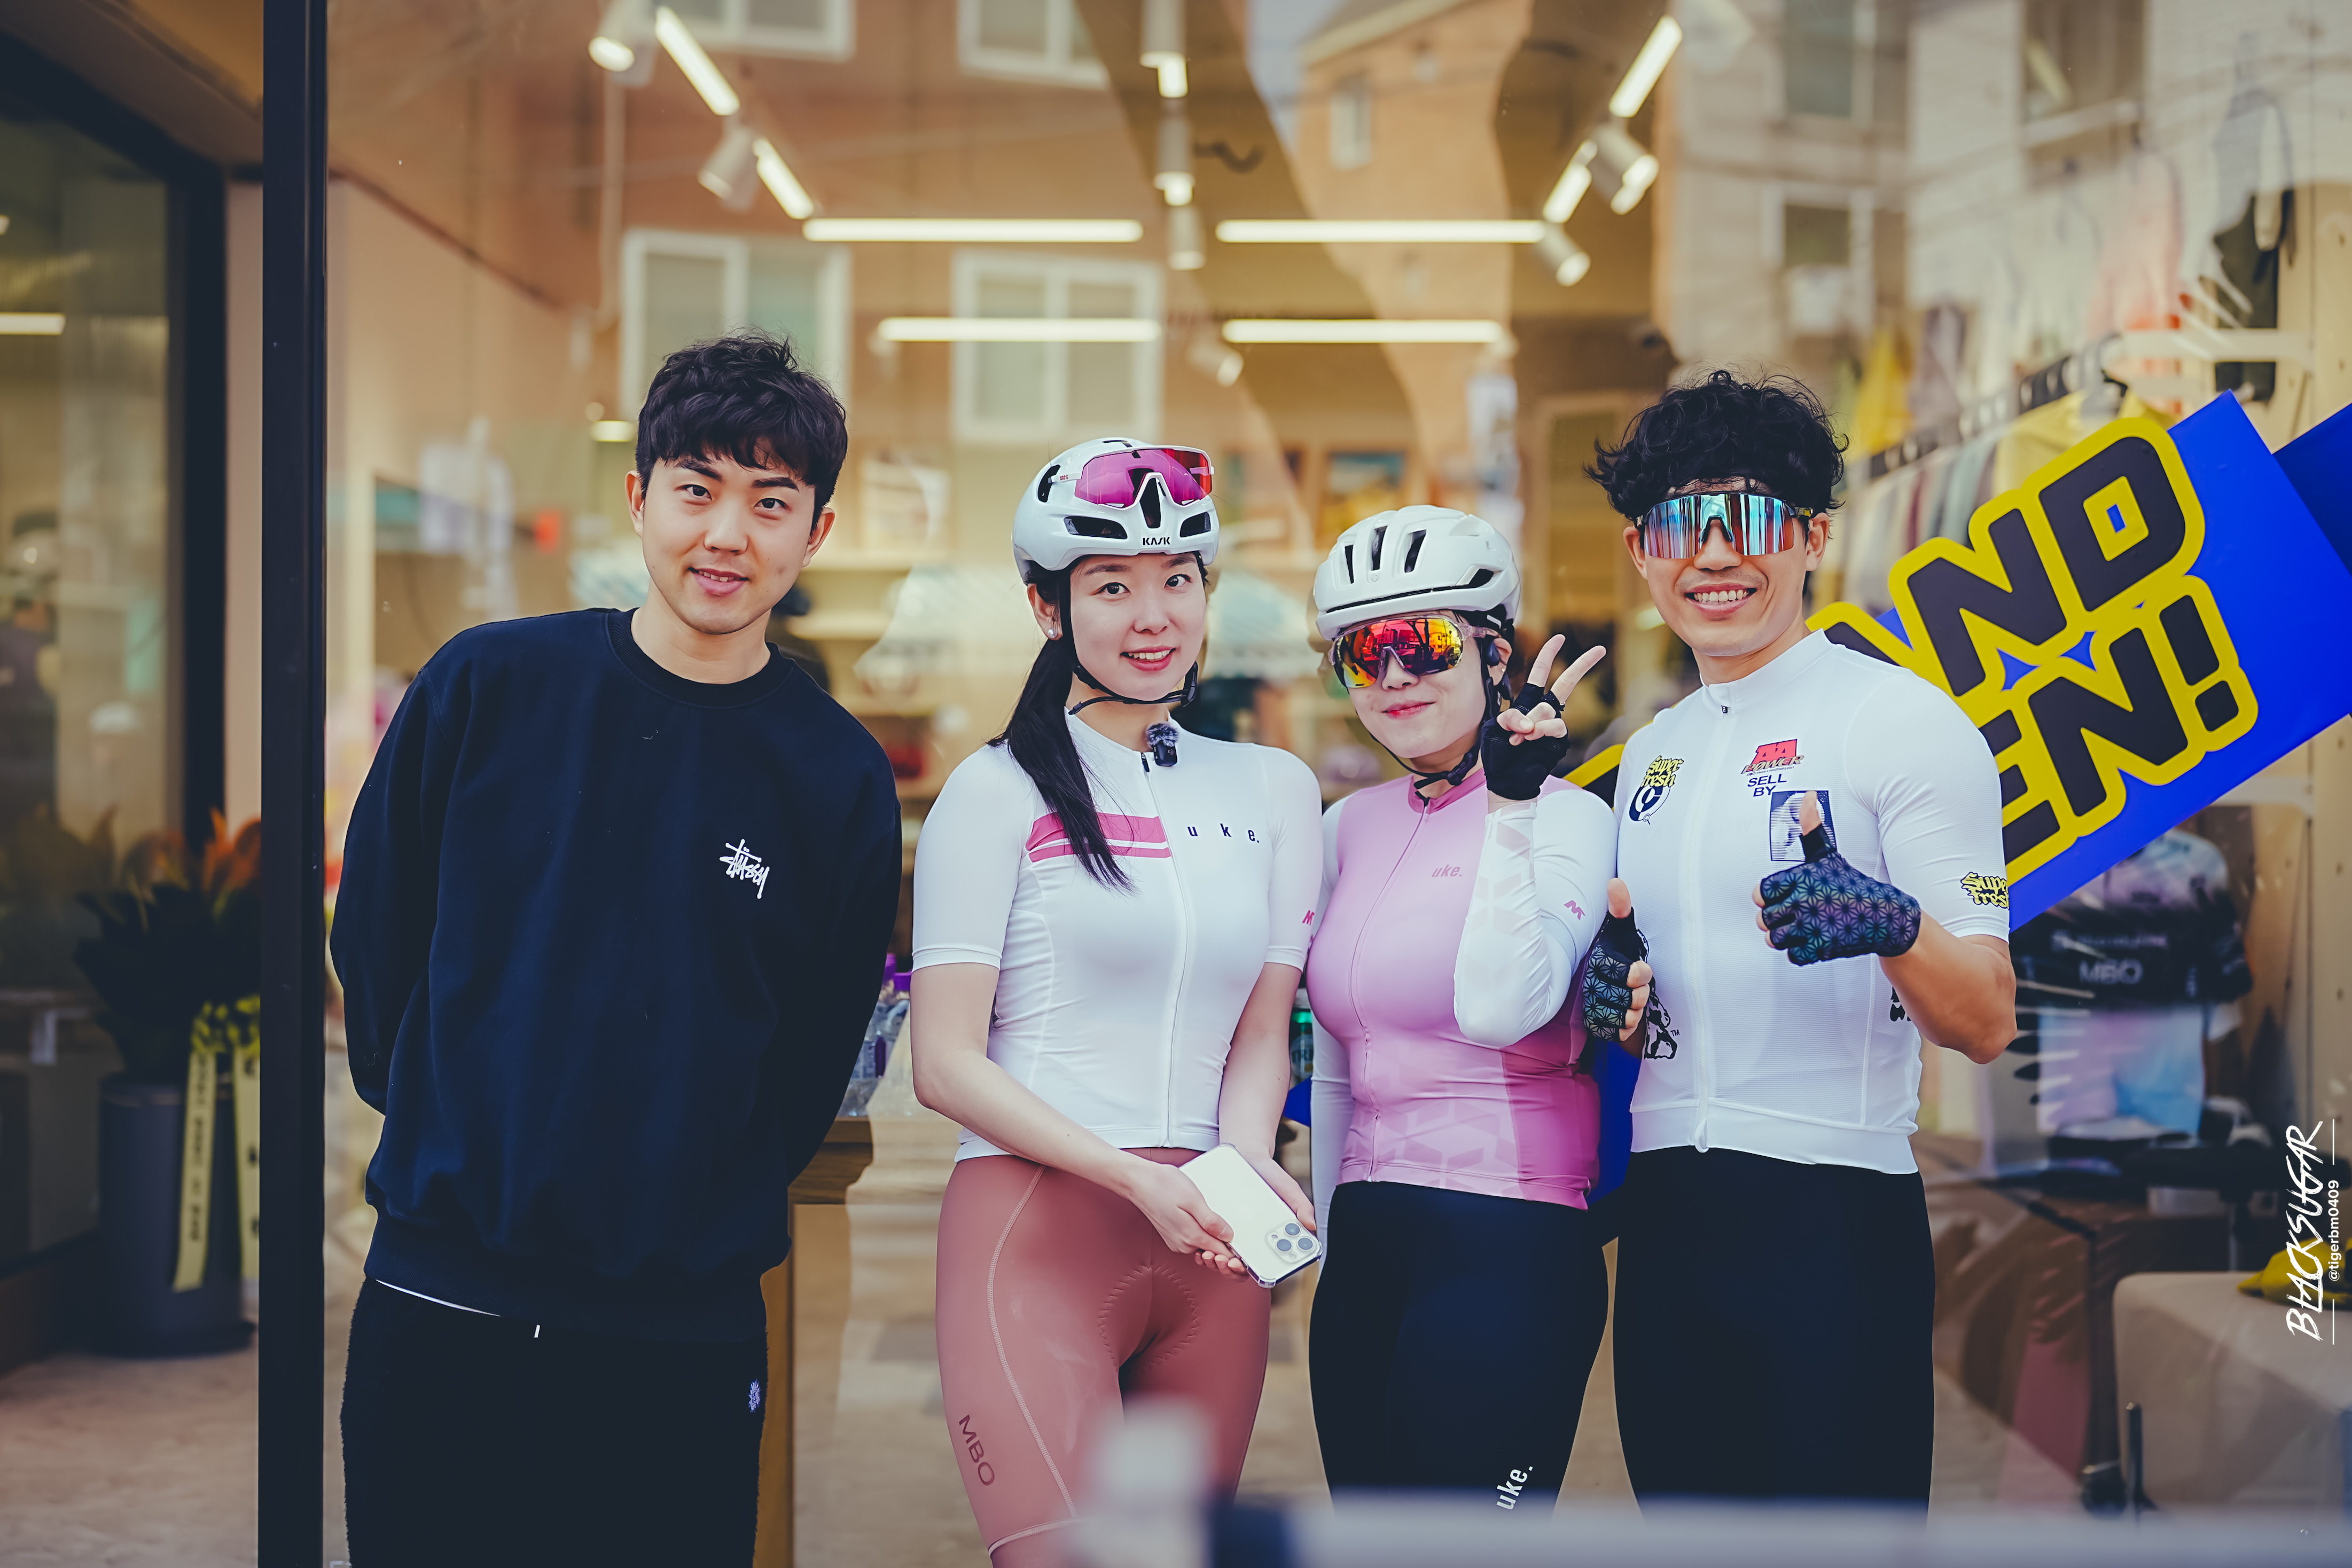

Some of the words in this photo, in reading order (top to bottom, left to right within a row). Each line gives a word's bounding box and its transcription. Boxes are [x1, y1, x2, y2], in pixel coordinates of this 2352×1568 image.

[1142, 537, 1171, 546] KASK
[1747, 773, 1787, 788] SELL
[1753, 785, 1777, 797] BY
[1431, 864, 1463, 877] uke.
[959, 1414, 995, 1486] MBO
[1496, 1465, 1533, 1510] uke.
